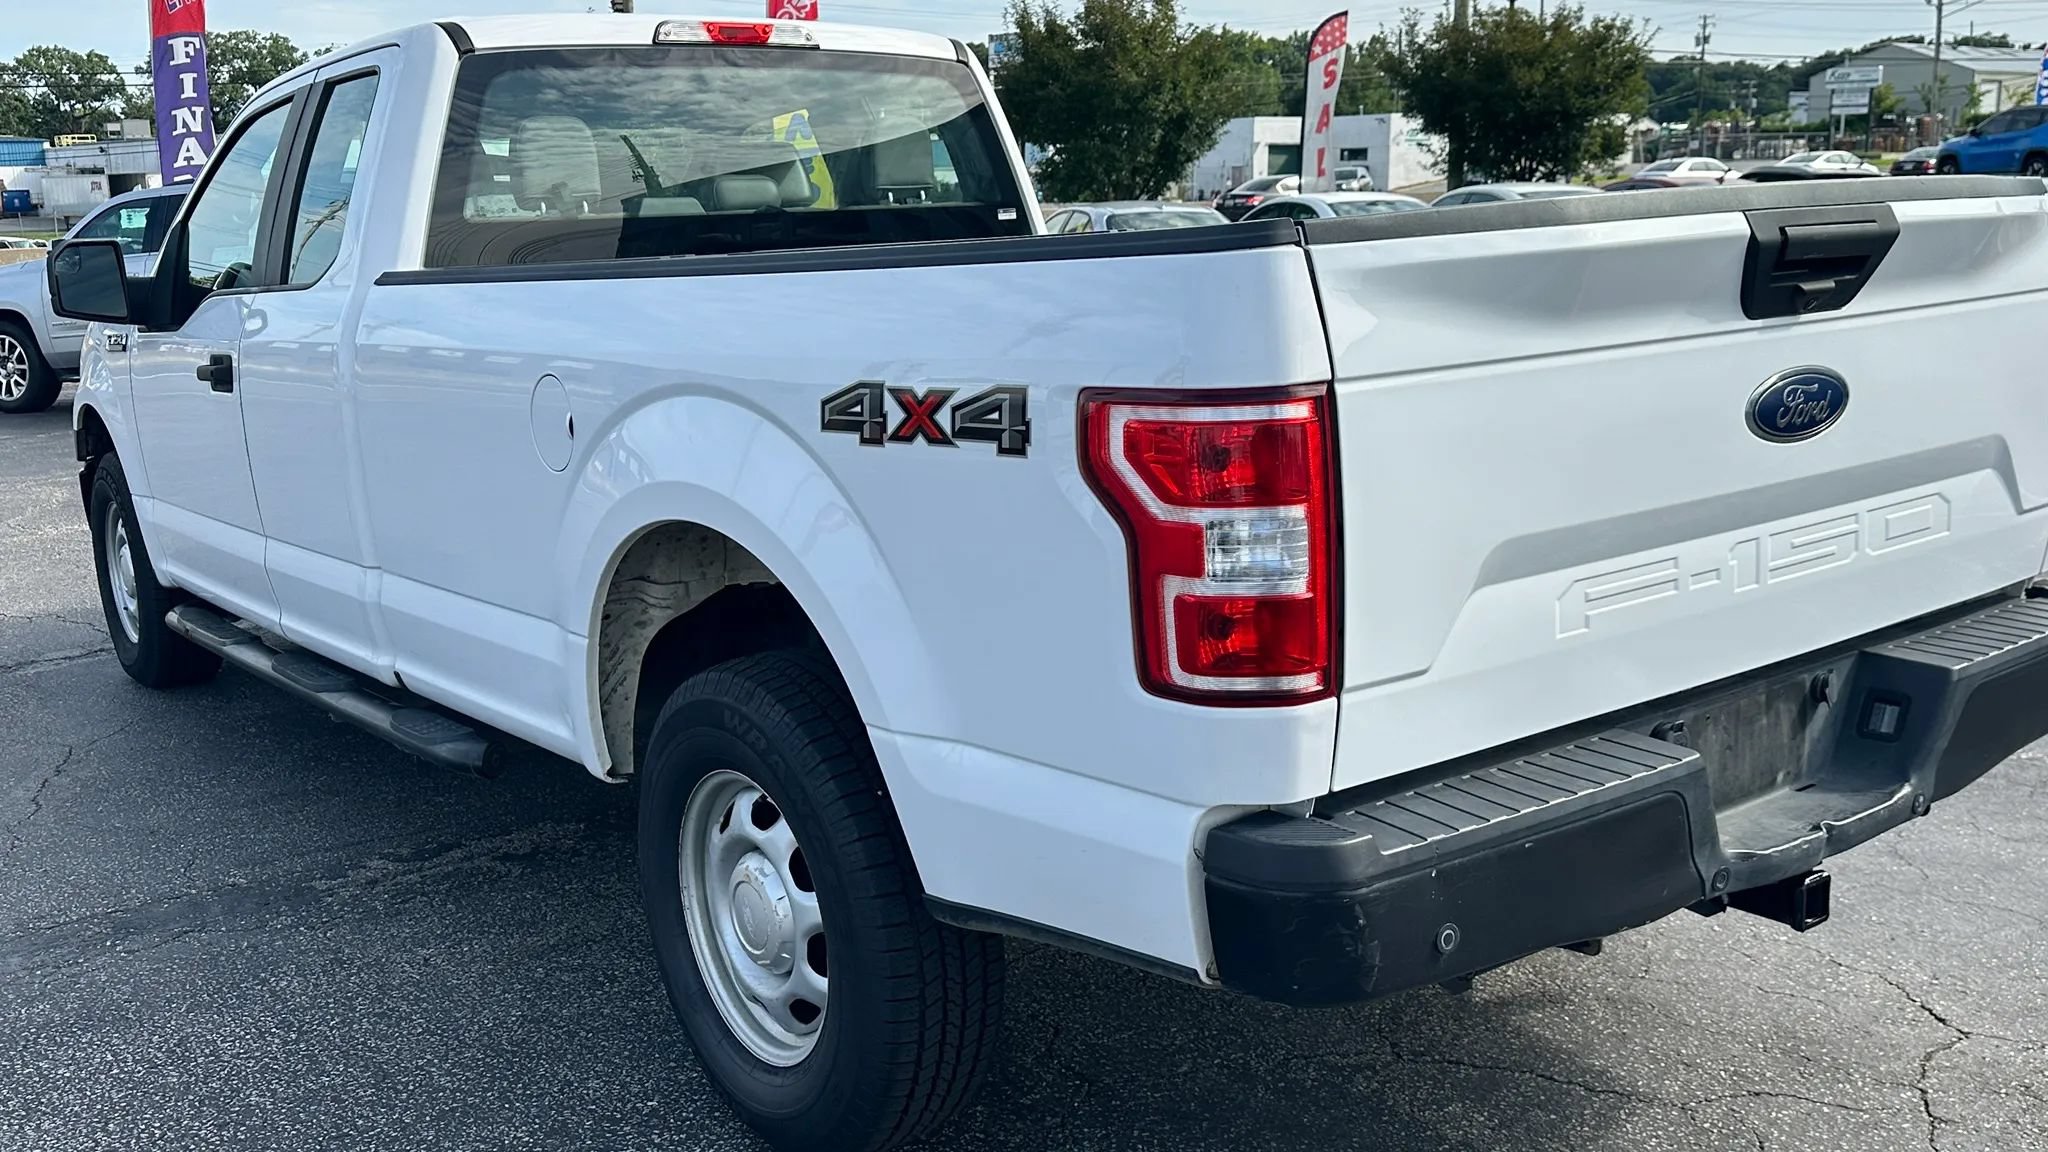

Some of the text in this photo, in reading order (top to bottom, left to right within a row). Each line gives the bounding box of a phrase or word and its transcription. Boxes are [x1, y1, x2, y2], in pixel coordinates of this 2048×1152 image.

[167, 36, 208, 182] FINA
[1776, 382, 1832, 429] Ford
[1556, 492, 1952, 639] F-150
